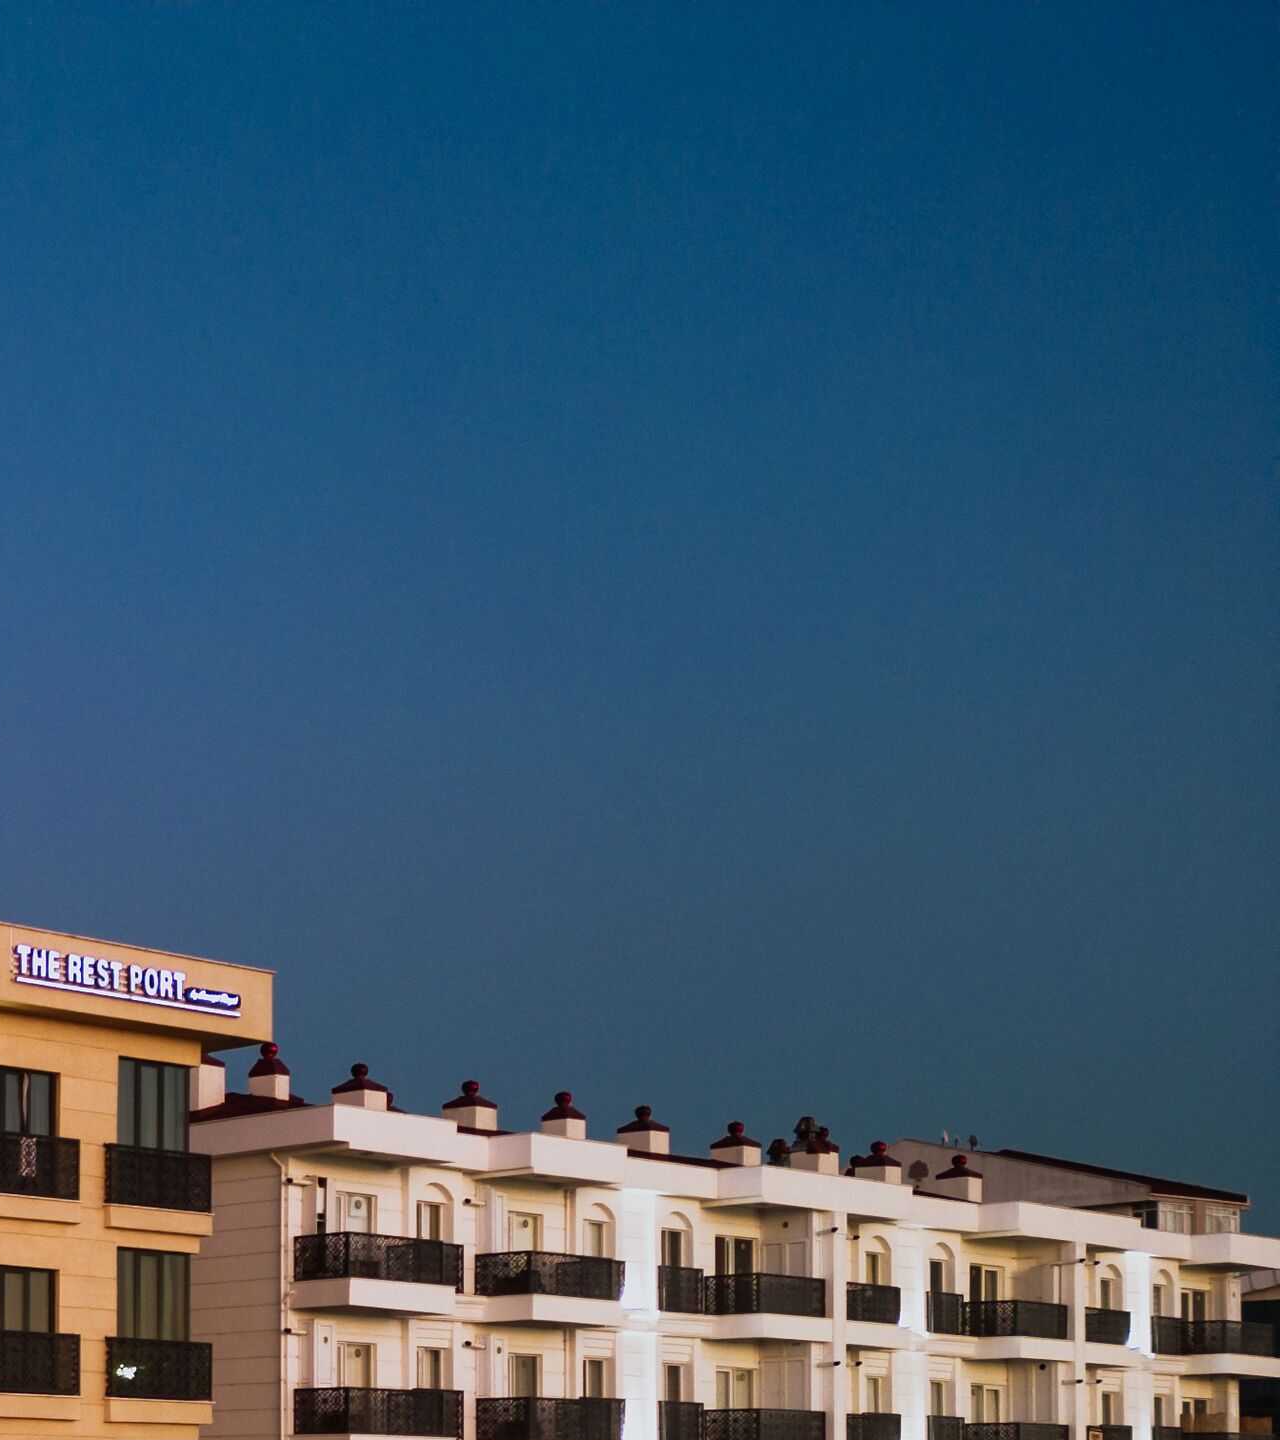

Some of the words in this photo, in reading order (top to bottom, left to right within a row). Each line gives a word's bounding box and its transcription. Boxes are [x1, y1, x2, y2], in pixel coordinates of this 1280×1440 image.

[16, 943, 61, 980] THE
[68, 953, 123, 990] REST
[129, 964, 186, 1000] PORT
